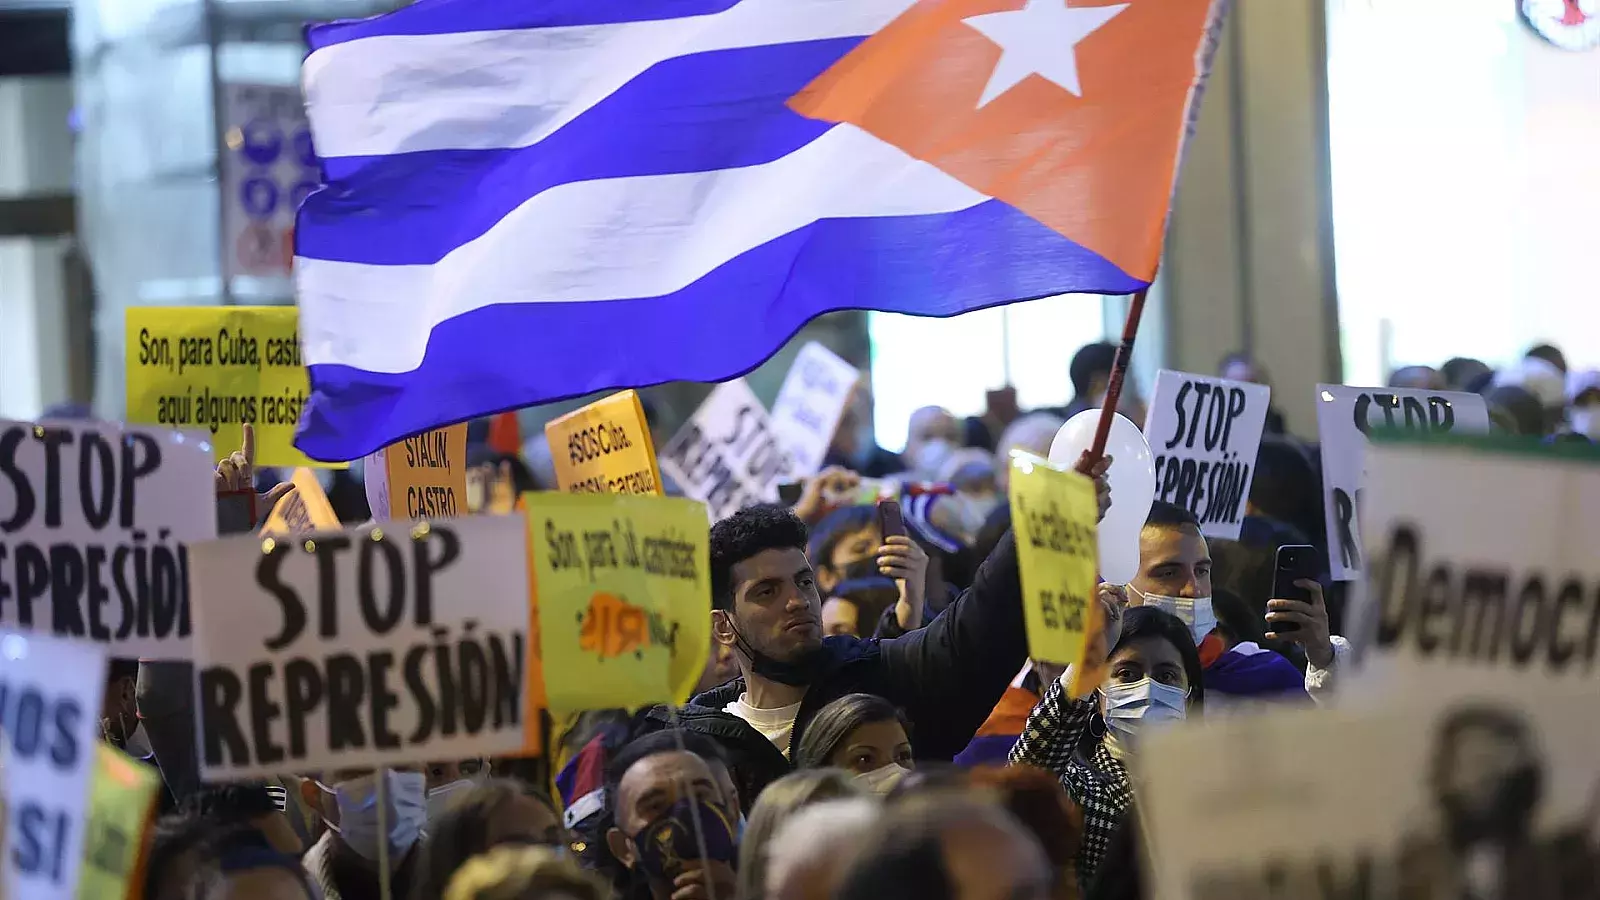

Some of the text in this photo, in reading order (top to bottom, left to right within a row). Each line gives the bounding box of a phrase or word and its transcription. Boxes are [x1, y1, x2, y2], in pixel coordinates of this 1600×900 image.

[139, 327, 174, 373] Son,
[178, 336, 213, 375] para
[217, 327, 262, 373] Cuba,
[157, 385, 192, 427] aquí
[196, 385, 257, 434] algunos
[1165, 380, 1246, 451] STOP
[0, 425, 162, 533] STOP
[404, 431, 451, 476] STALIN,
[256, 523, 460, 651] STOP
[200, 619, 522, 767] REPRESIÓN
